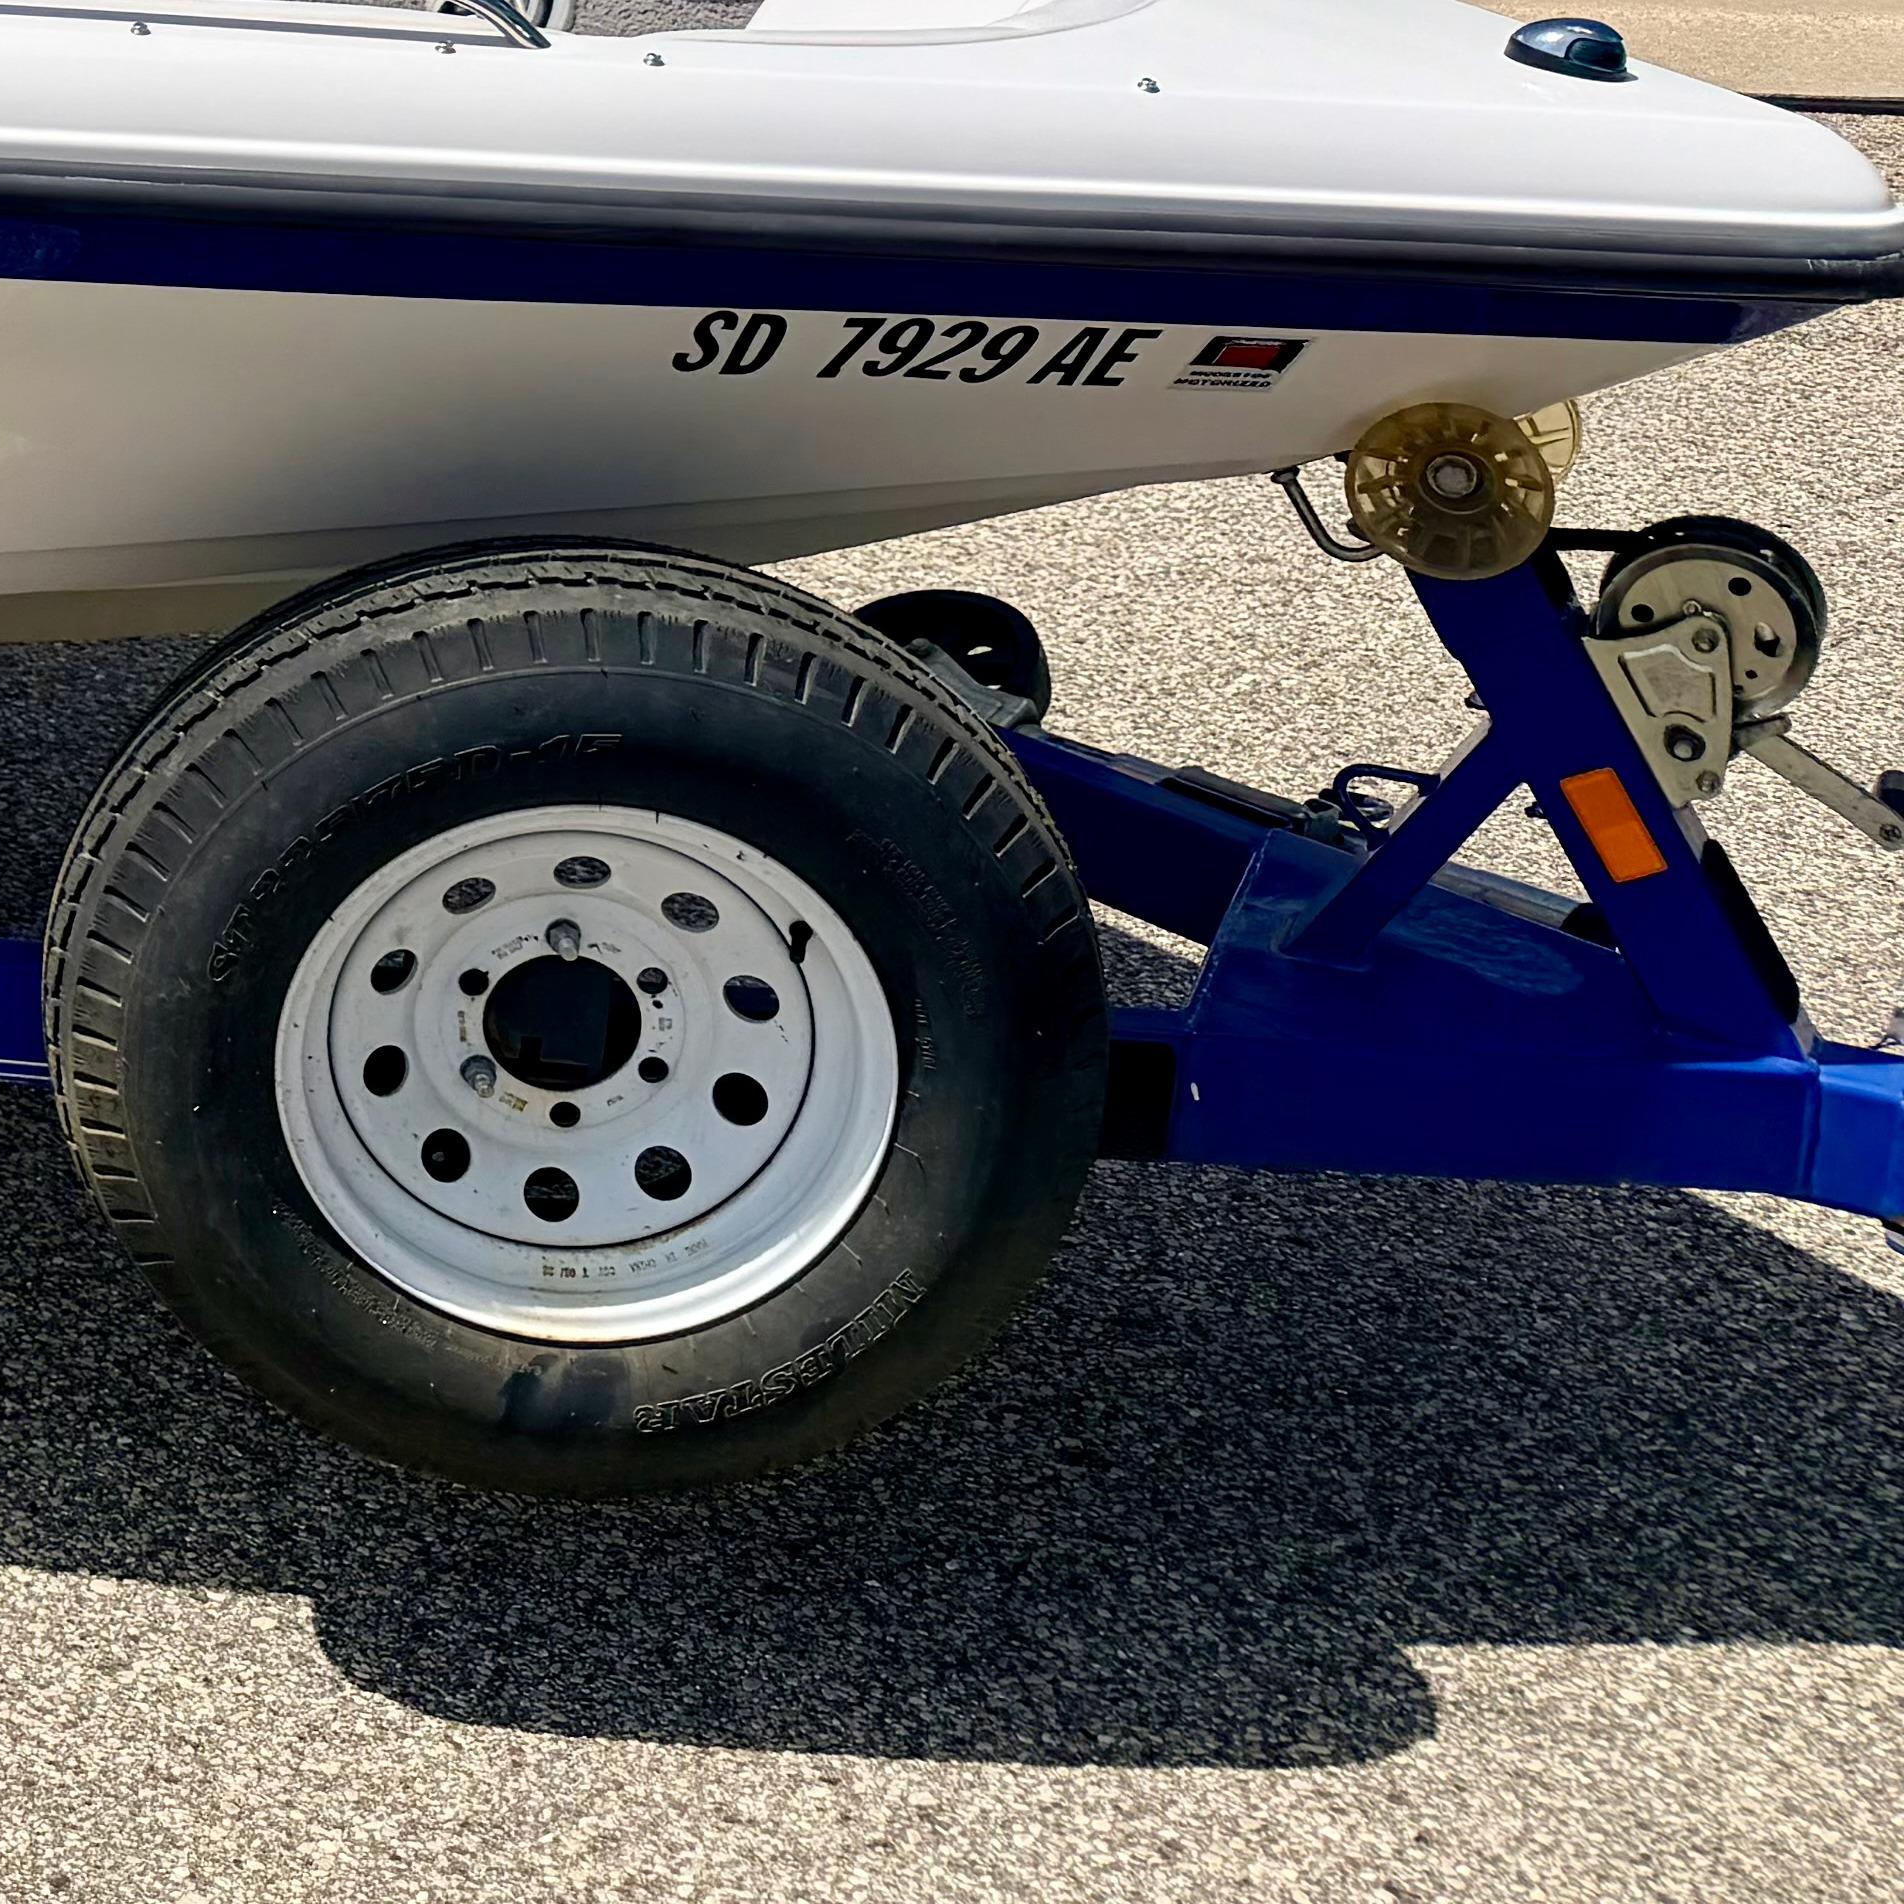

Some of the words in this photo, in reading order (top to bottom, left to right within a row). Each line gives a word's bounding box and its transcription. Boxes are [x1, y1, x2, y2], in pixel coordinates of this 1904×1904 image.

[671, 310, 789, 375] SD
[815, 316, 1041, 384] 7929
[1027, 327, 1164, 387] AE
[632, 1266, 928, 1434] MILESTAR
